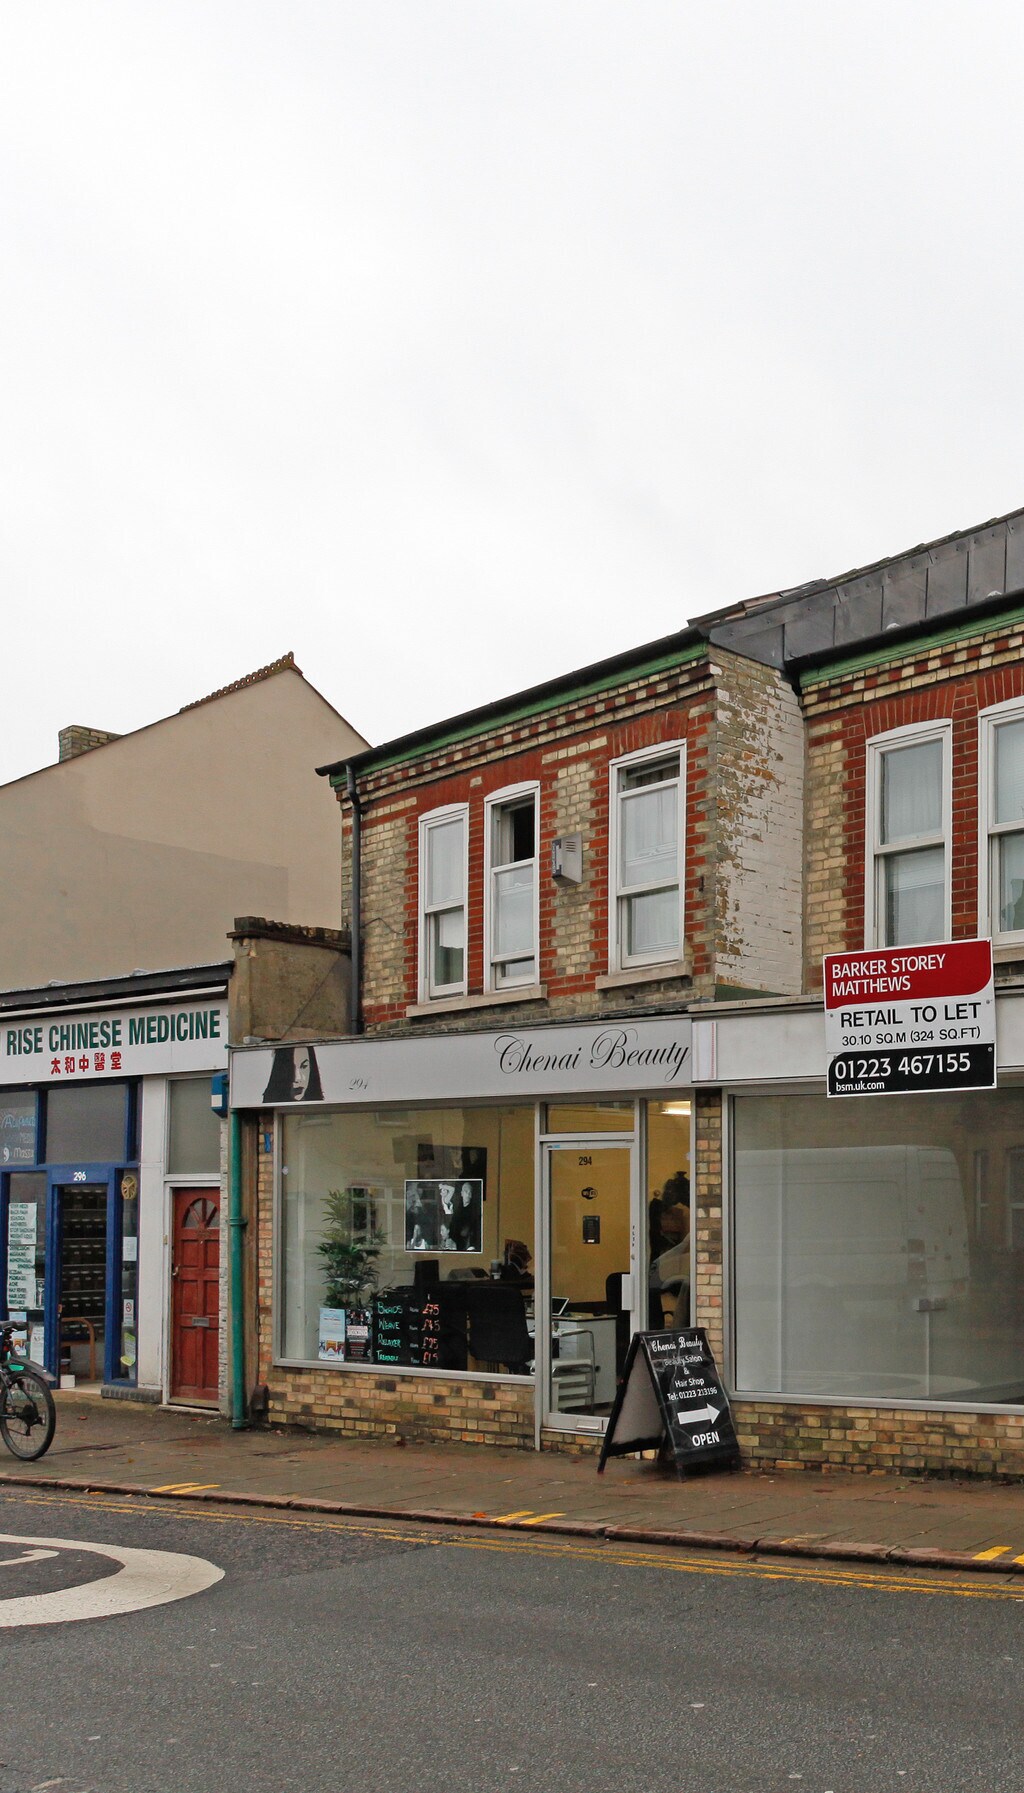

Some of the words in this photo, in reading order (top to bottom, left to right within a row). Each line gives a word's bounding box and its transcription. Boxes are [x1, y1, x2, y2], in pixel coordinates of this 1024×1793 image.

[832, 959, 887, 979] BARKER
[891, 953, 946, 974] STOREY
[832, 975, 911, 997] MATTHEWS
[840, 1008, 903, 1028] RETAIL
[910, 1005, 937, 1023] TO
[944, 1002, 982, 1021] LET
[6, 1027, 44, 1056] RISE
[49, 1019, 122, 1053] CHINESE
[129, 1009, 221, 1046] MEDICINE
[842, 1034, 872, 1046] 30.10
[876, 1032, 906, 1044] SQ.M
[910, 1030, 935, 1043] (324
[939, 1026, 981, 1040] SQ.FT)
[51, 1051, 122, 1075] 太和中醫堂
[494, 1034, 582, 1074] Chenai
[590, 1028, 691, 1082] Beauty
[834, 1057, 892, 1080] 01223
[898, 1052, 971, 1076] 467155
[835, 1080, 885, 1092] bsm.uk.com
[578, 1156, 592, 1166] 294
[73, 1171, 87, 1182] 296
[651, 1340, 677, 1352] Chenai
[678, 1335, 703, 1352] Beauty
[683, 1367, 690, 1375] &
[675, 1379, 688, 1388] Hair
[689, 1378, 705, 1387] Shop
[667, 1392, 679, 1401] Tel:
[679, 1390, 697, 1400] 01223
[692, 1431, 720, 1447] OPEN
